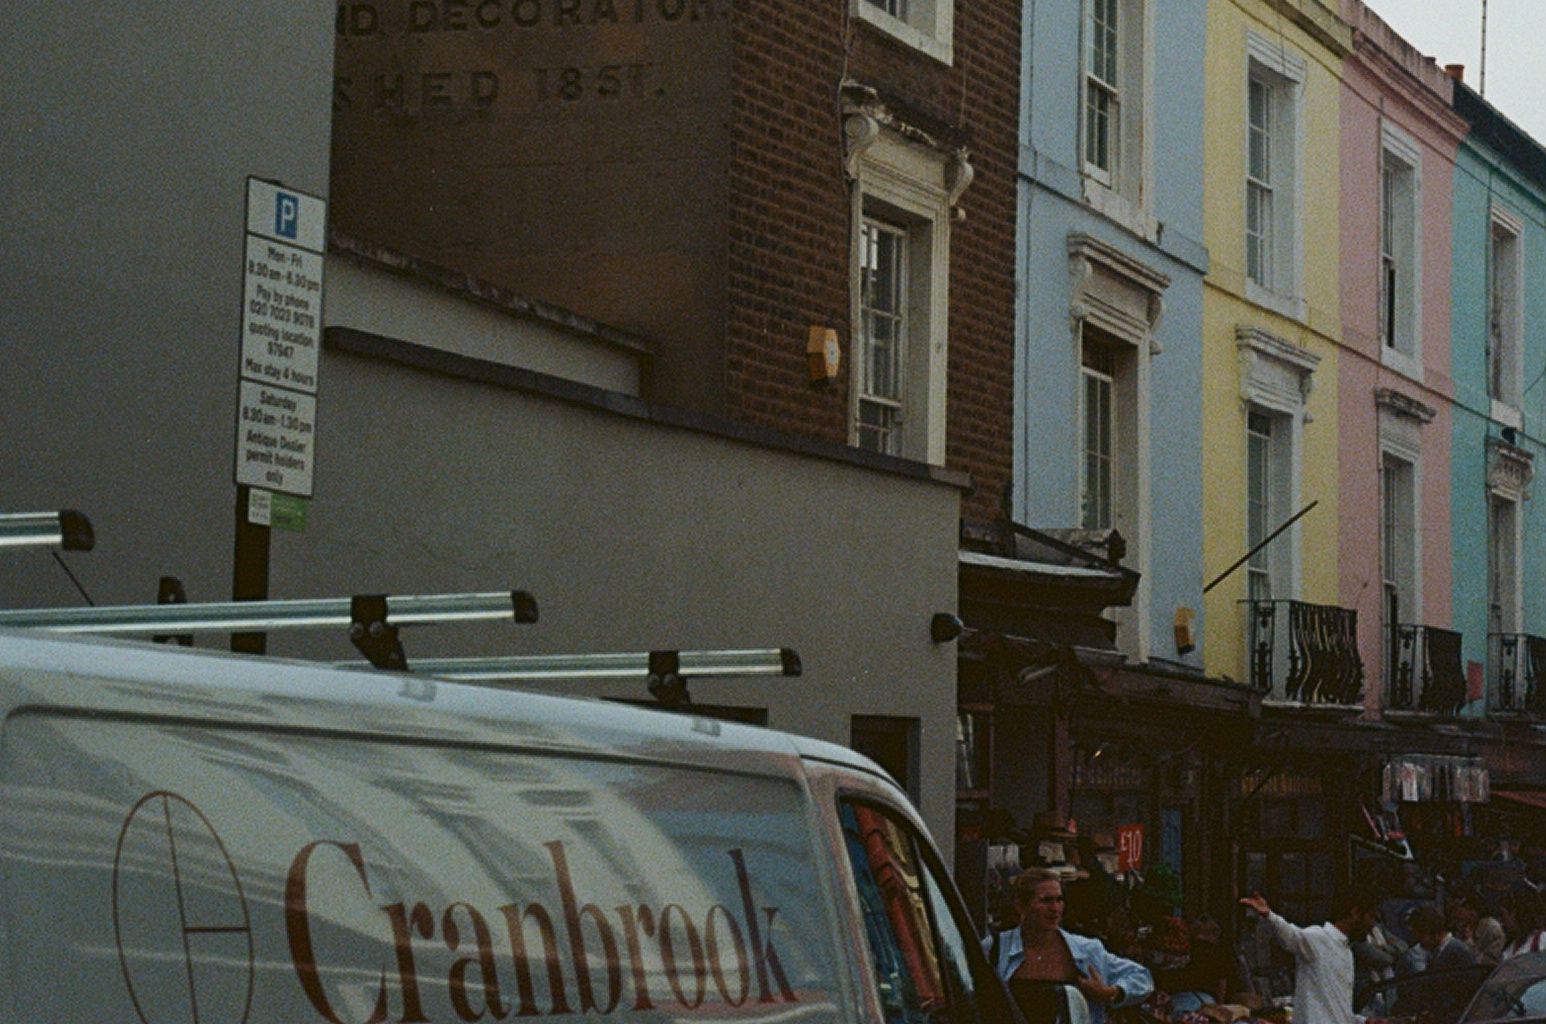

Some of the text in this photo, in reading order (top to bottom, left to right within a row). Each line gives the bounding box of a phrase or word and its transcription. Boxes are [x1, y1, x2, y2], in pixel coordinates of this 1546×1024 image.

[281, 198, 295, 232] P
[260, 391, 297, 413] Saturday
[285, 839, 798, 1024] Cranbrook
